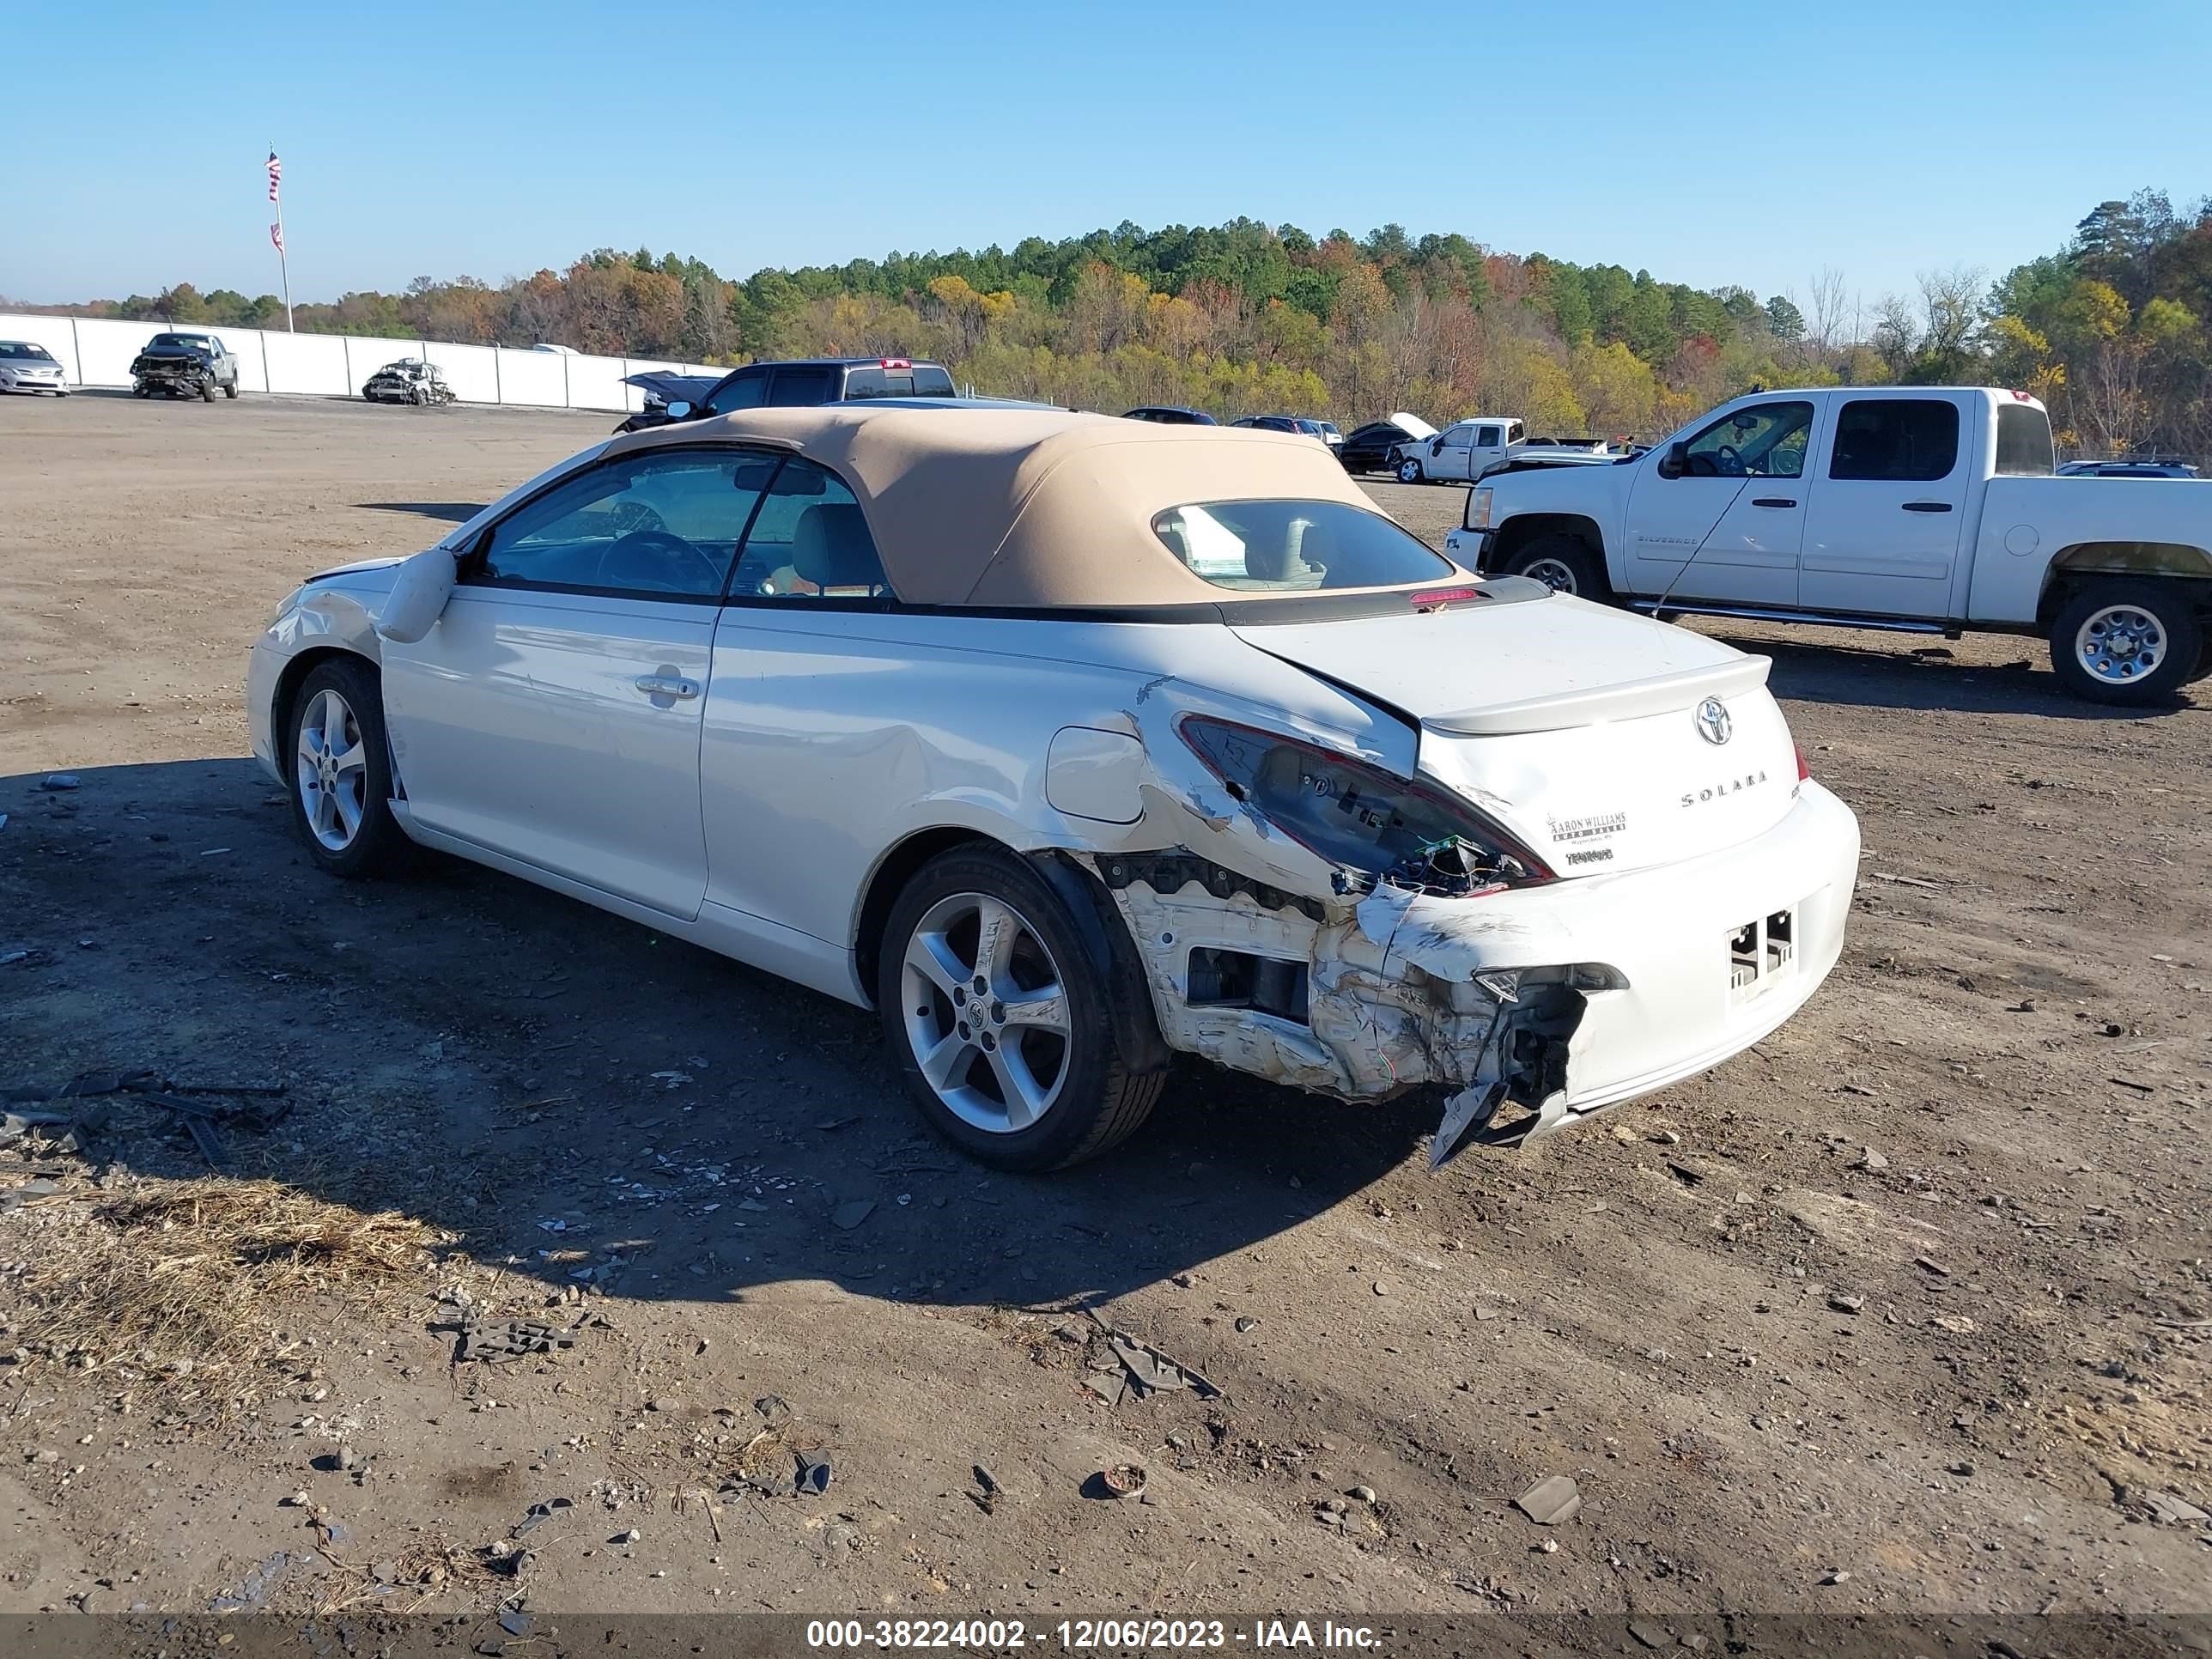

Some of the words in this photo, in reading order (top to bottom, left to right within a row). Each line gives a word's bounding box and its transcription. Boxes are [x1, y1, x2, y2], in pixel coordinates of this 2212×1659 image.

[1637, 535, 1698, 545] SILVERADO
[1680, 769, 1767, 808] SOLARA
[1551, 819, 1583, 834] AARON
[1584, 811, 1626, 829] WILLIAMS
[1555, 831, 1583, 842] AUTO
[1591, 825, 1625, 836] SALES
